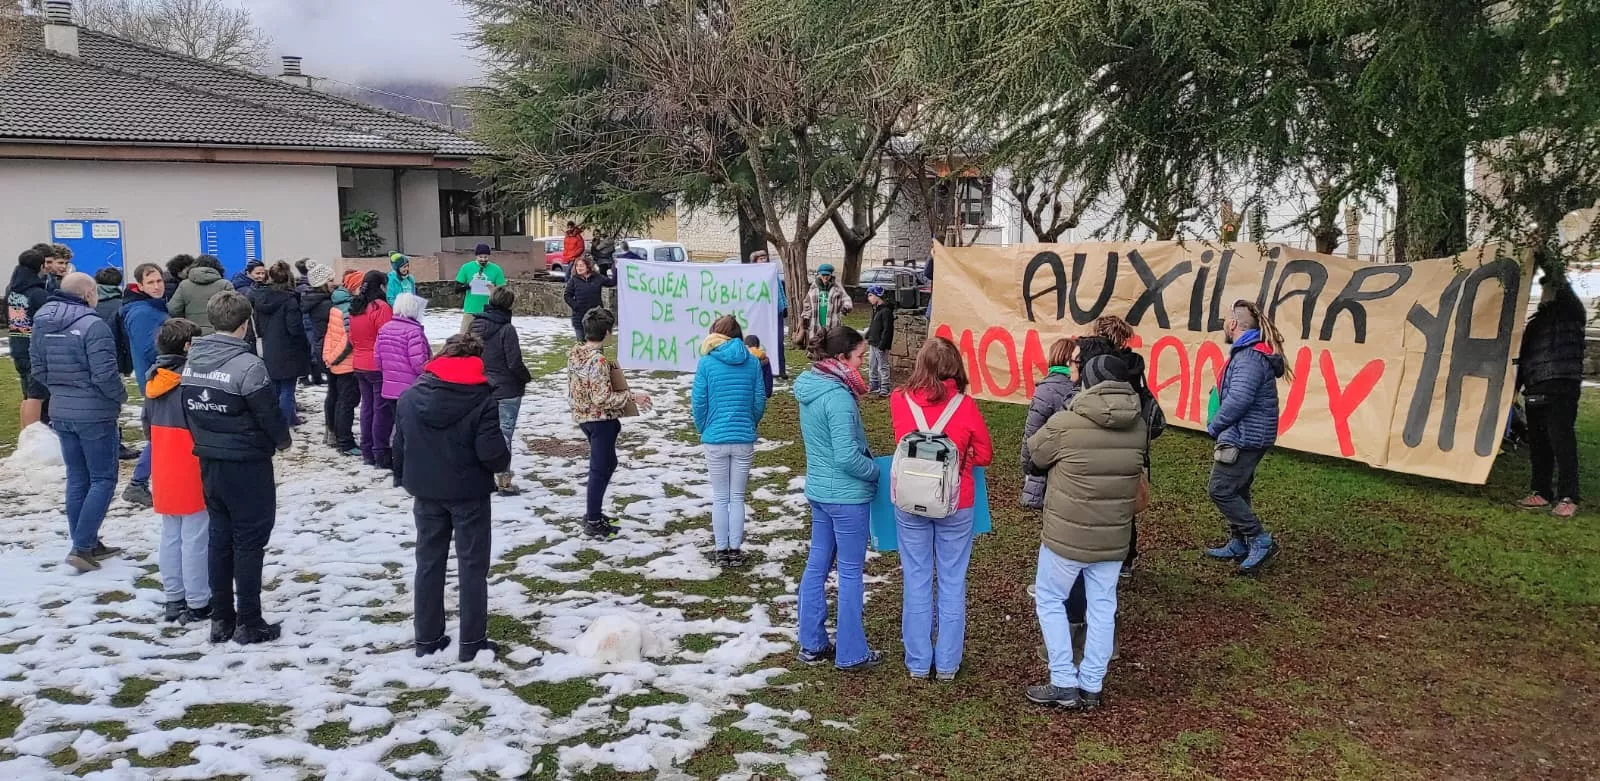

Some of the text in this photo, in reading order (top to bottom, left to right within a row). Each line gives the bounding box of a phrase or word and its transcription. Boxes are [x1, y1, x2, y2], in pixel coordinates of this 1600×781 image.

[626, 264, 689, 299] ESCUELA
[652, 300, 749, 331] DE TOS
[631, 330, 678, 365] PARA
[1405, 257, 1521, 457] YA
